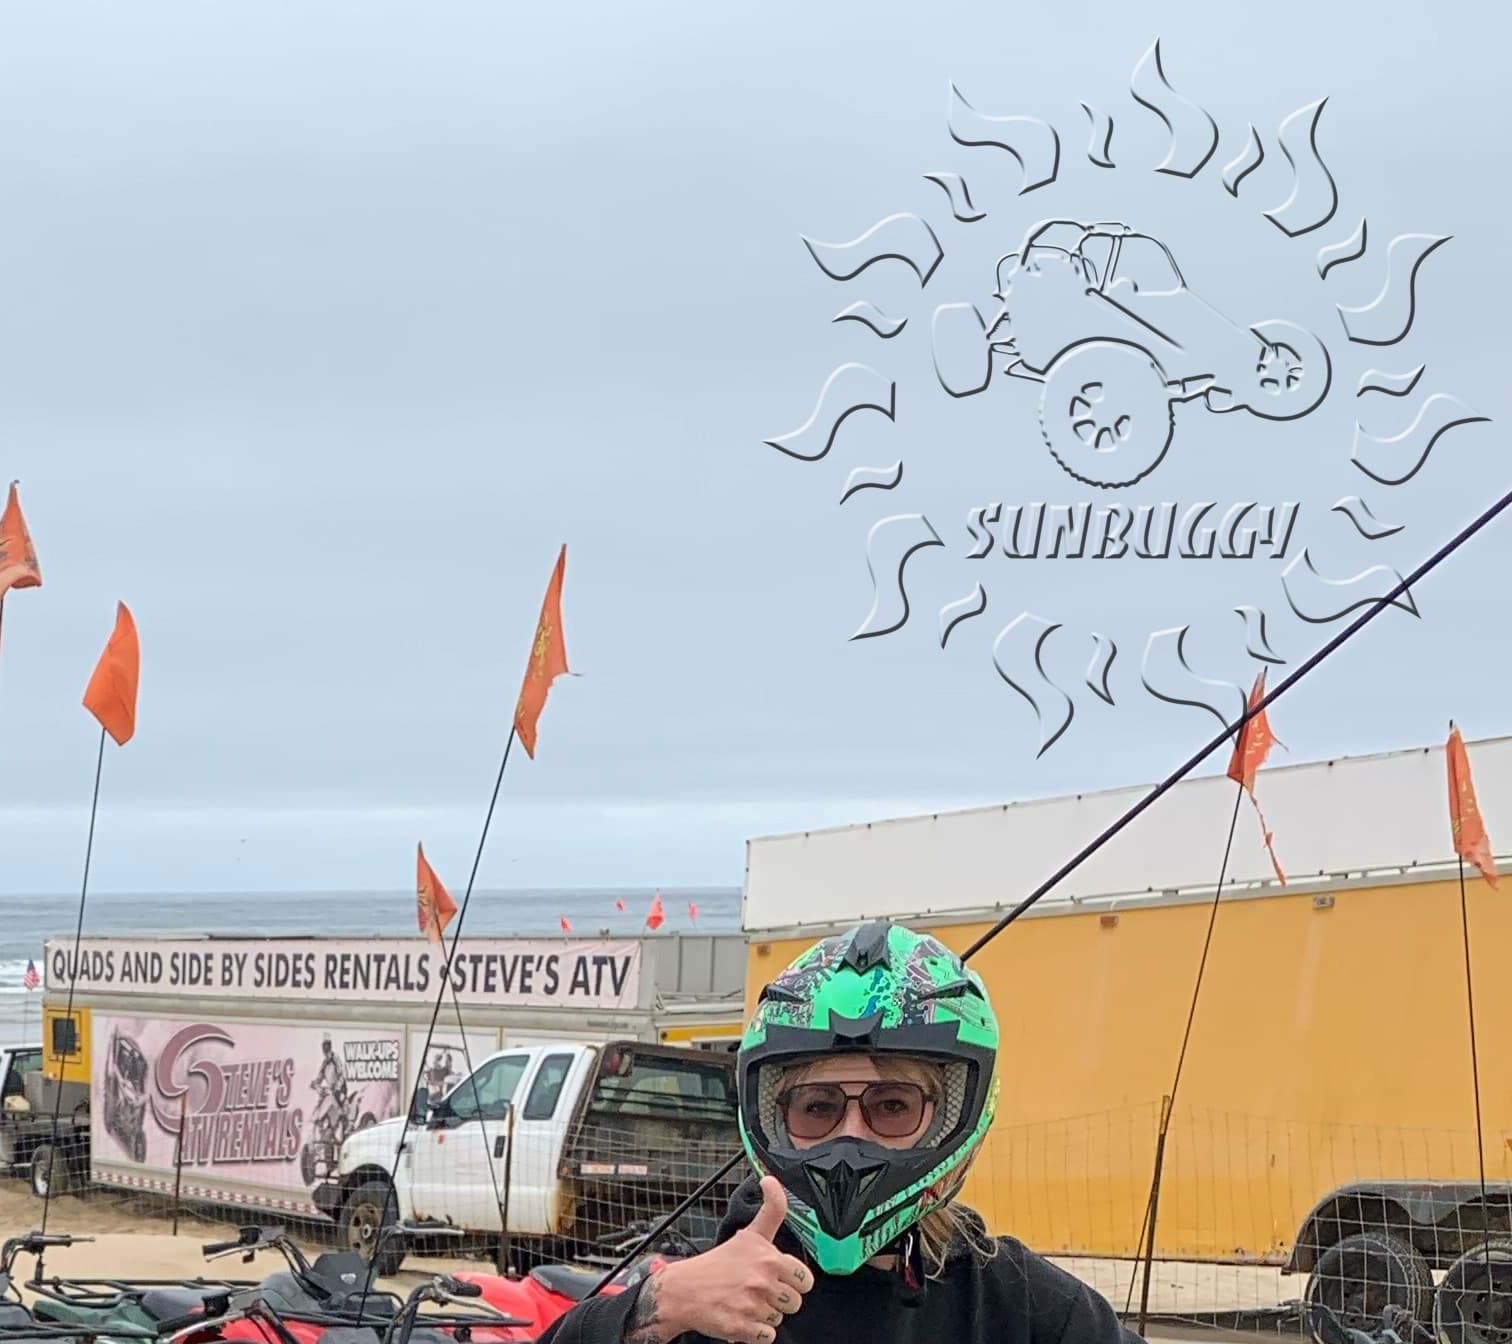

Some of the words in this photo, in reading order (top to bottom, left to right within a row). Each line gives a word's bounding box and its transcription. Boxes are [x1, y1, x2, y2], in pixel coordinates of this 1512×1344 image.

[52, 949, 115, 983] QUADS
[120, 951, 163, 983] AND
[169, 951, 213, 986] SIDE
[221, 952, 248, 987] BY
[253, 952, 315, 989] SIDES
[324, 953, 430, 992] RENTALS
[452, 953, 560, 995] STEVE'S
[568, 955, 632, 997] ATV
[343, 1040, 400, 1062] WALK-UPS
[344, 1060, 399, 1081] WELCOME
[150, 1023, 295, 1134] STEVE'S
[174, 1113, 216, 1167] ATV
[212, 1107, 304, 1166] RENTALS
